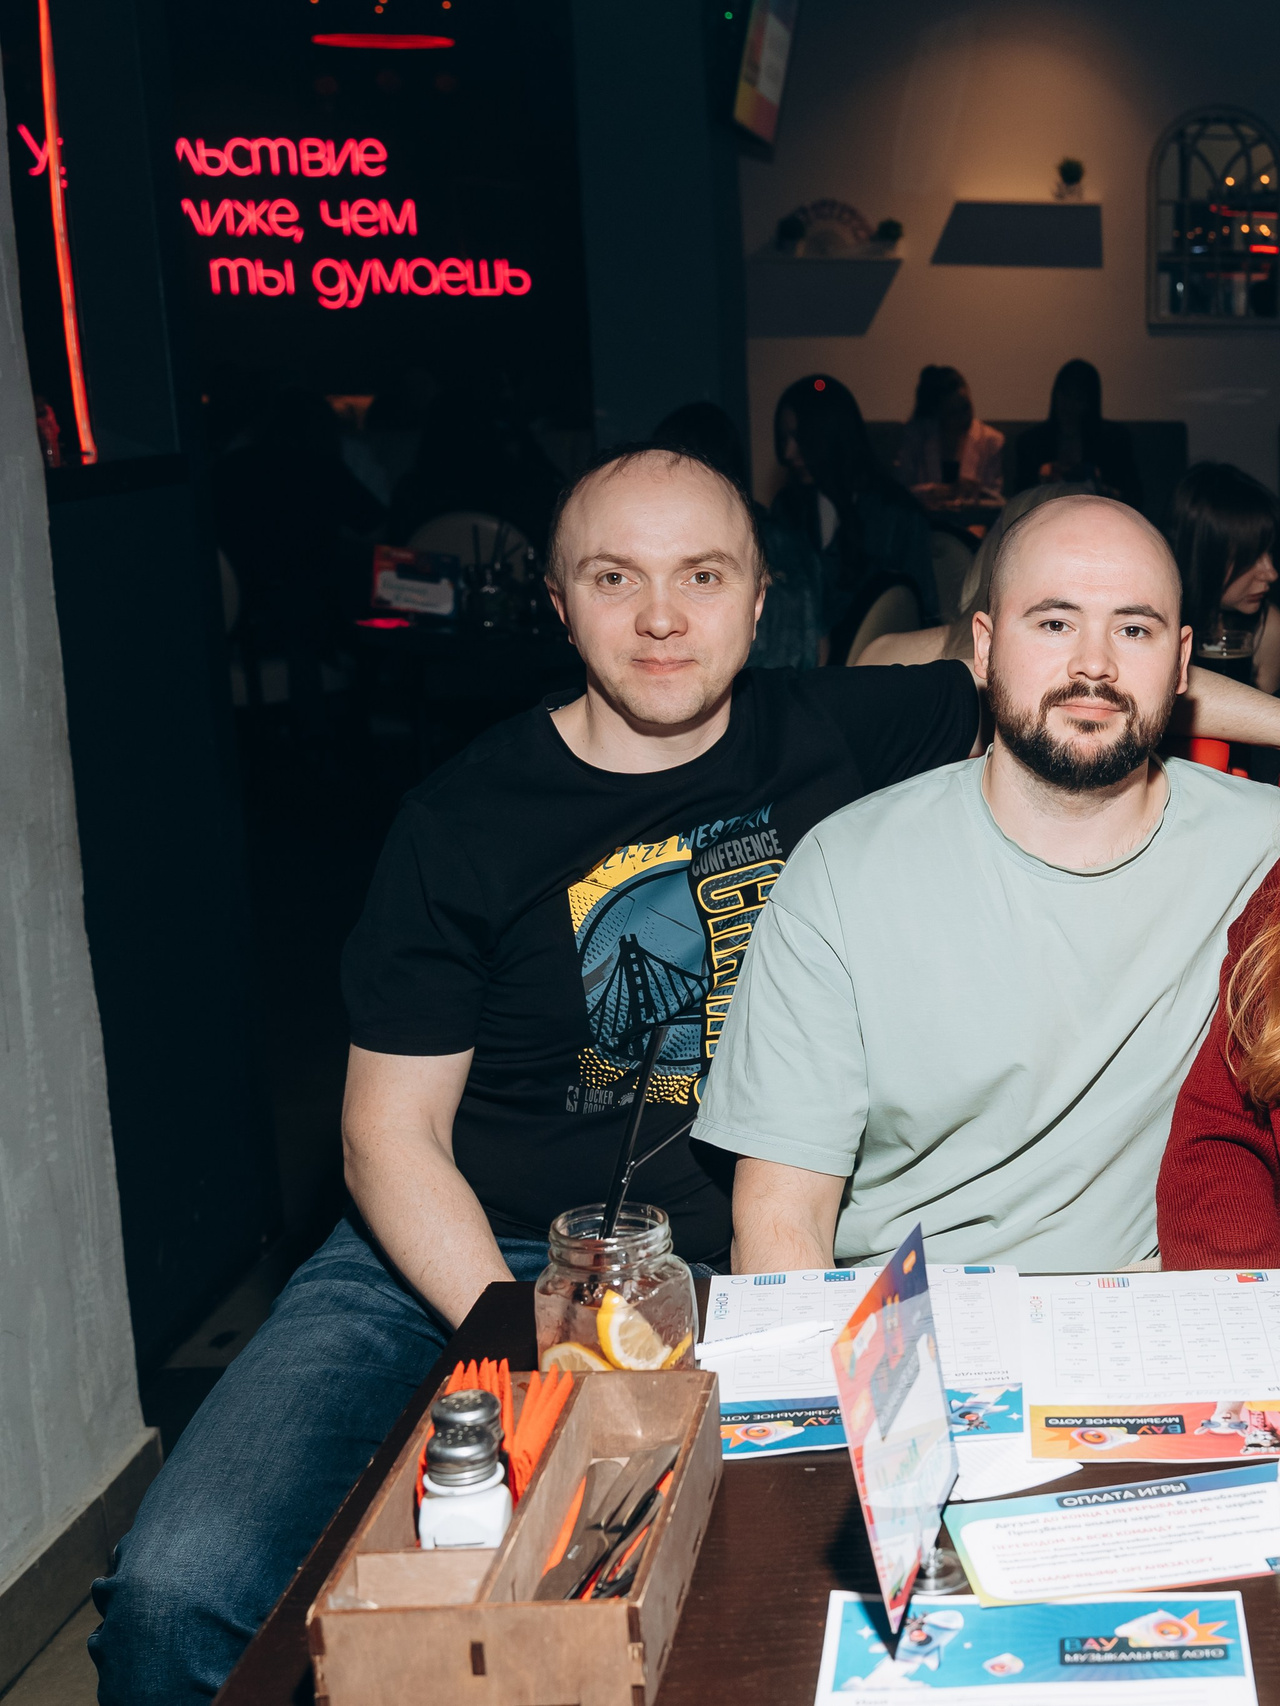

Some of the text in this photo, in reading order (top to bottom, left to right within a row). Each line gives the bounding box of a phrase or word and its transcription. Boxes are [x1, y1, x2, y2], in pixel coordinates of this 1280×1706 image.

[319, 198, 418, 238] чем
[210, 257, 532, 311] ты думаешь
[676, 801, 774, 852] WESTERN
[691, 828, 783, 877] CONFERENCE
[584, 1088, 614, 1105] LOCKER
[1047, 1416, 1181, 1425] МУЗЫКАЛЬНОЕ ЛОТО
[1137, 1424, 1182, 1435] ВАУ
[1062, 1482, 1187, 1507] ОПЛАТА ИГРЫ
[1063, 1636, 1120, 1652] ВАУ
[1064, 1647, 1225, 1664] МУЗЫКАЛЬНОЕ ЛОТО
